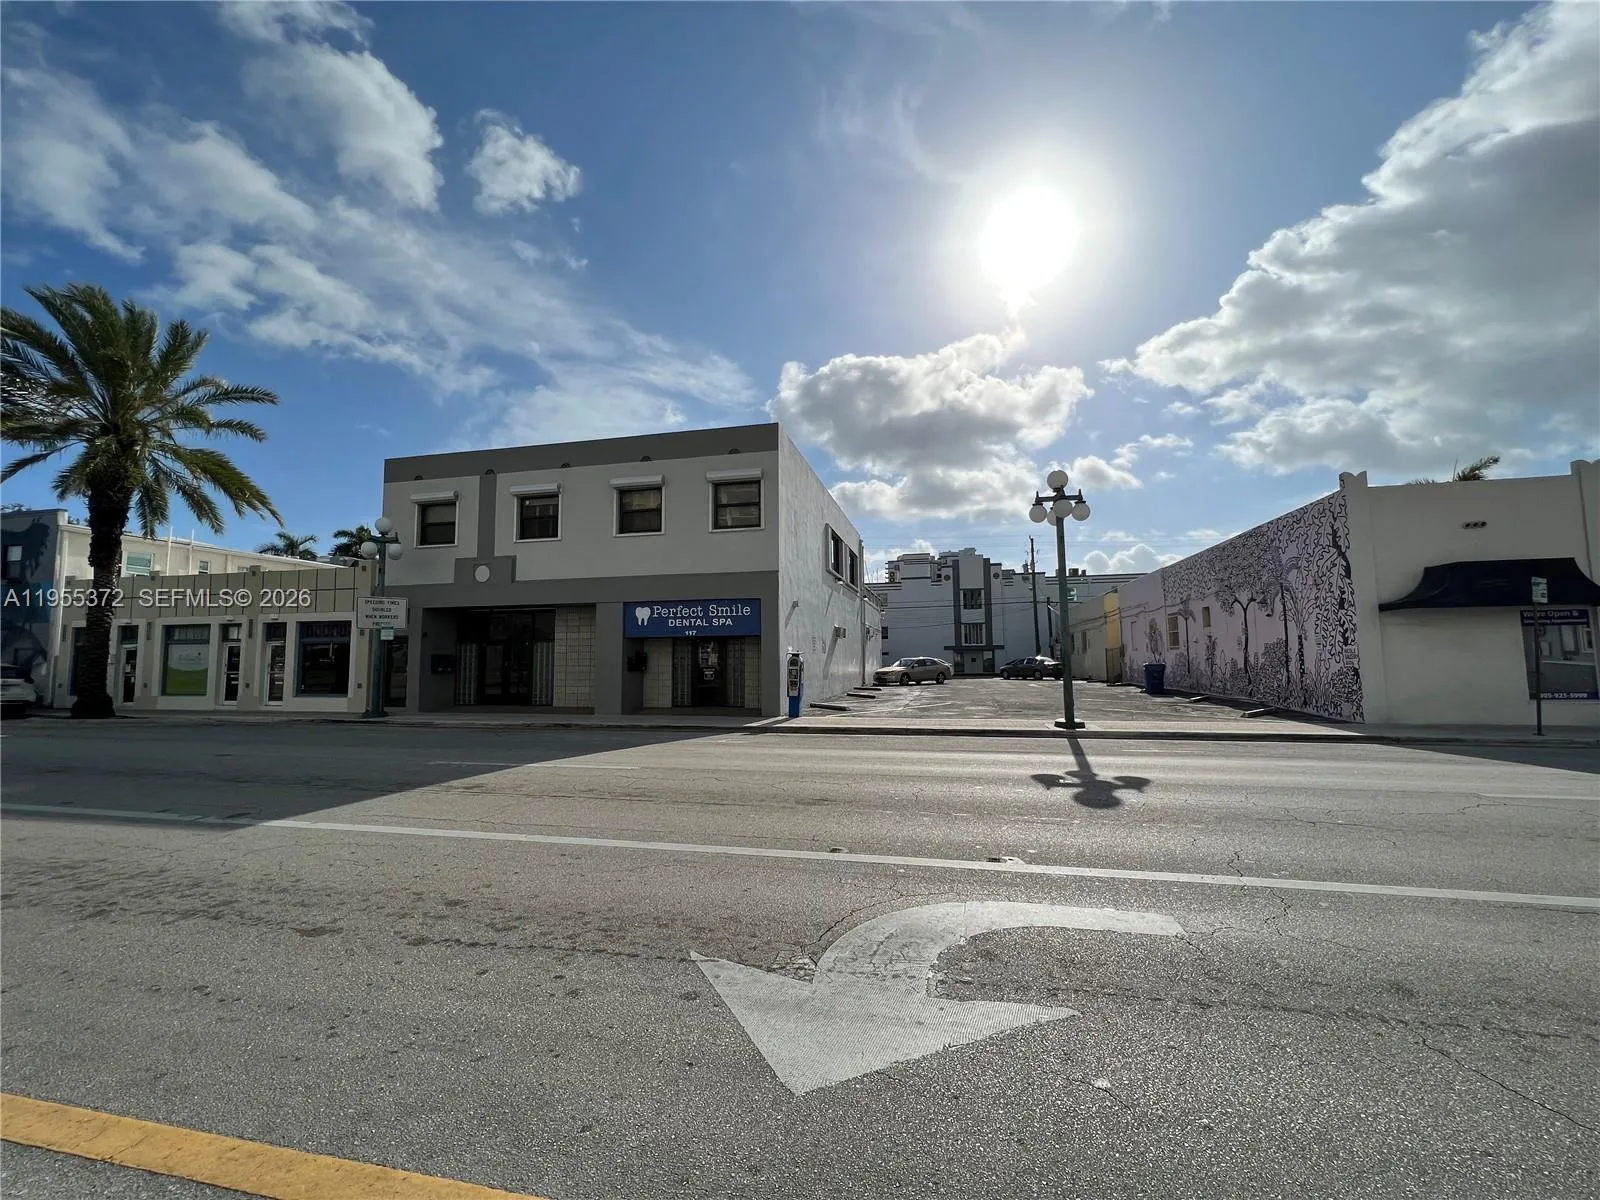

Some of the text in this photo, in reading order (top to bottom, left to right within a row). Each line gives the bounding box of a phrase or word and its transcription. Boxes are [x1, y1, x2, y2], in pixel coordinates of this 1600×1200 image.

[652, 603, 751, 618] Perfect Smile
[1547, 610, 1570, 618] Open
[668, 618, 733, 627] DENTAL SPA
